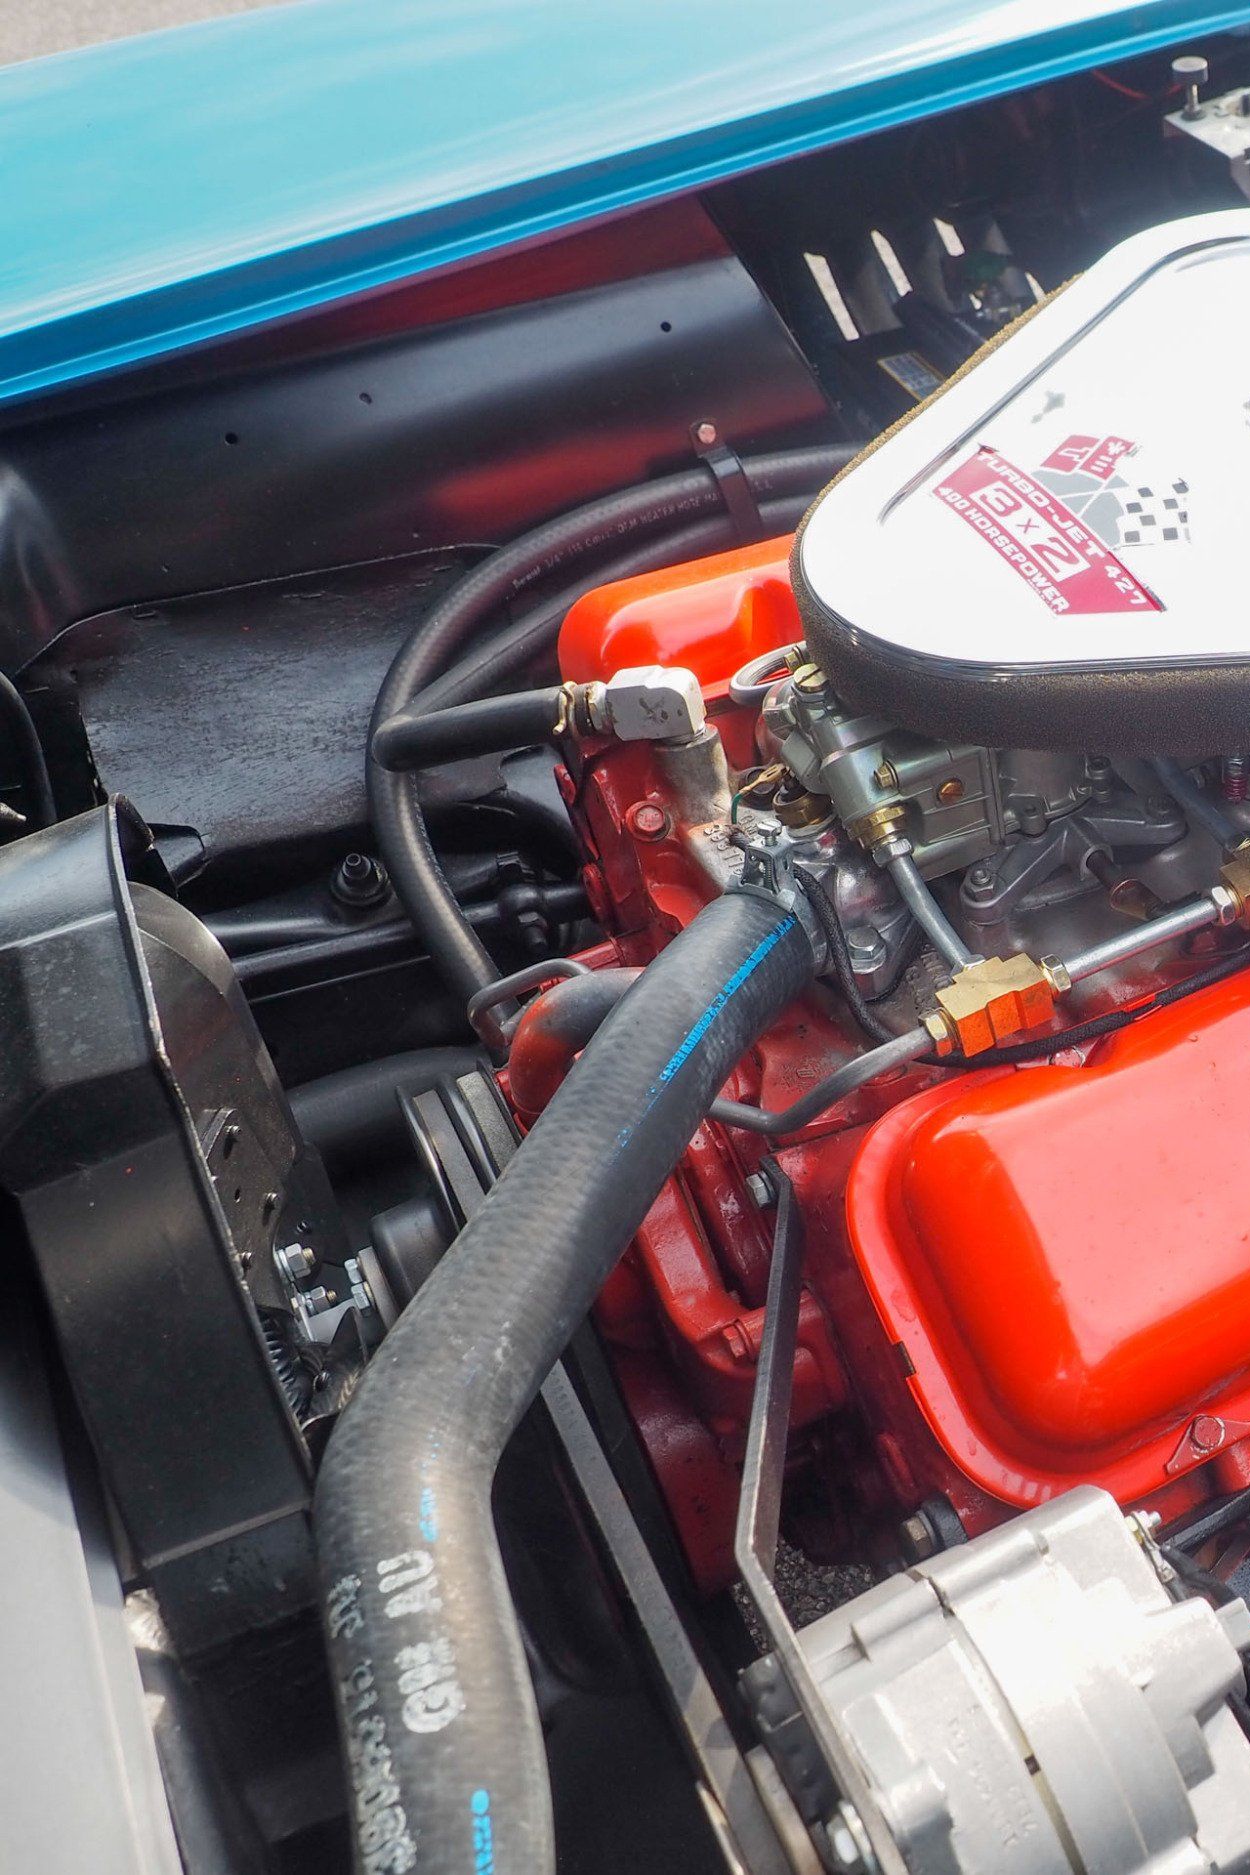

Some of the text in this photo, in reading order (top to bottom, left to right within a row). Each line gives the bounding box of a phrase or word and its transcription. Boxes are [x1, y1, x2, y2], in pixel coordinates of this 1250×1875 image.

[937, 486, 971, 510] 400
[963, 507, 1071, 613] HORSEPOWER
[976, 451, 1107, 558] TURBO-JET
[1104, 563, 1148, 605] 427
